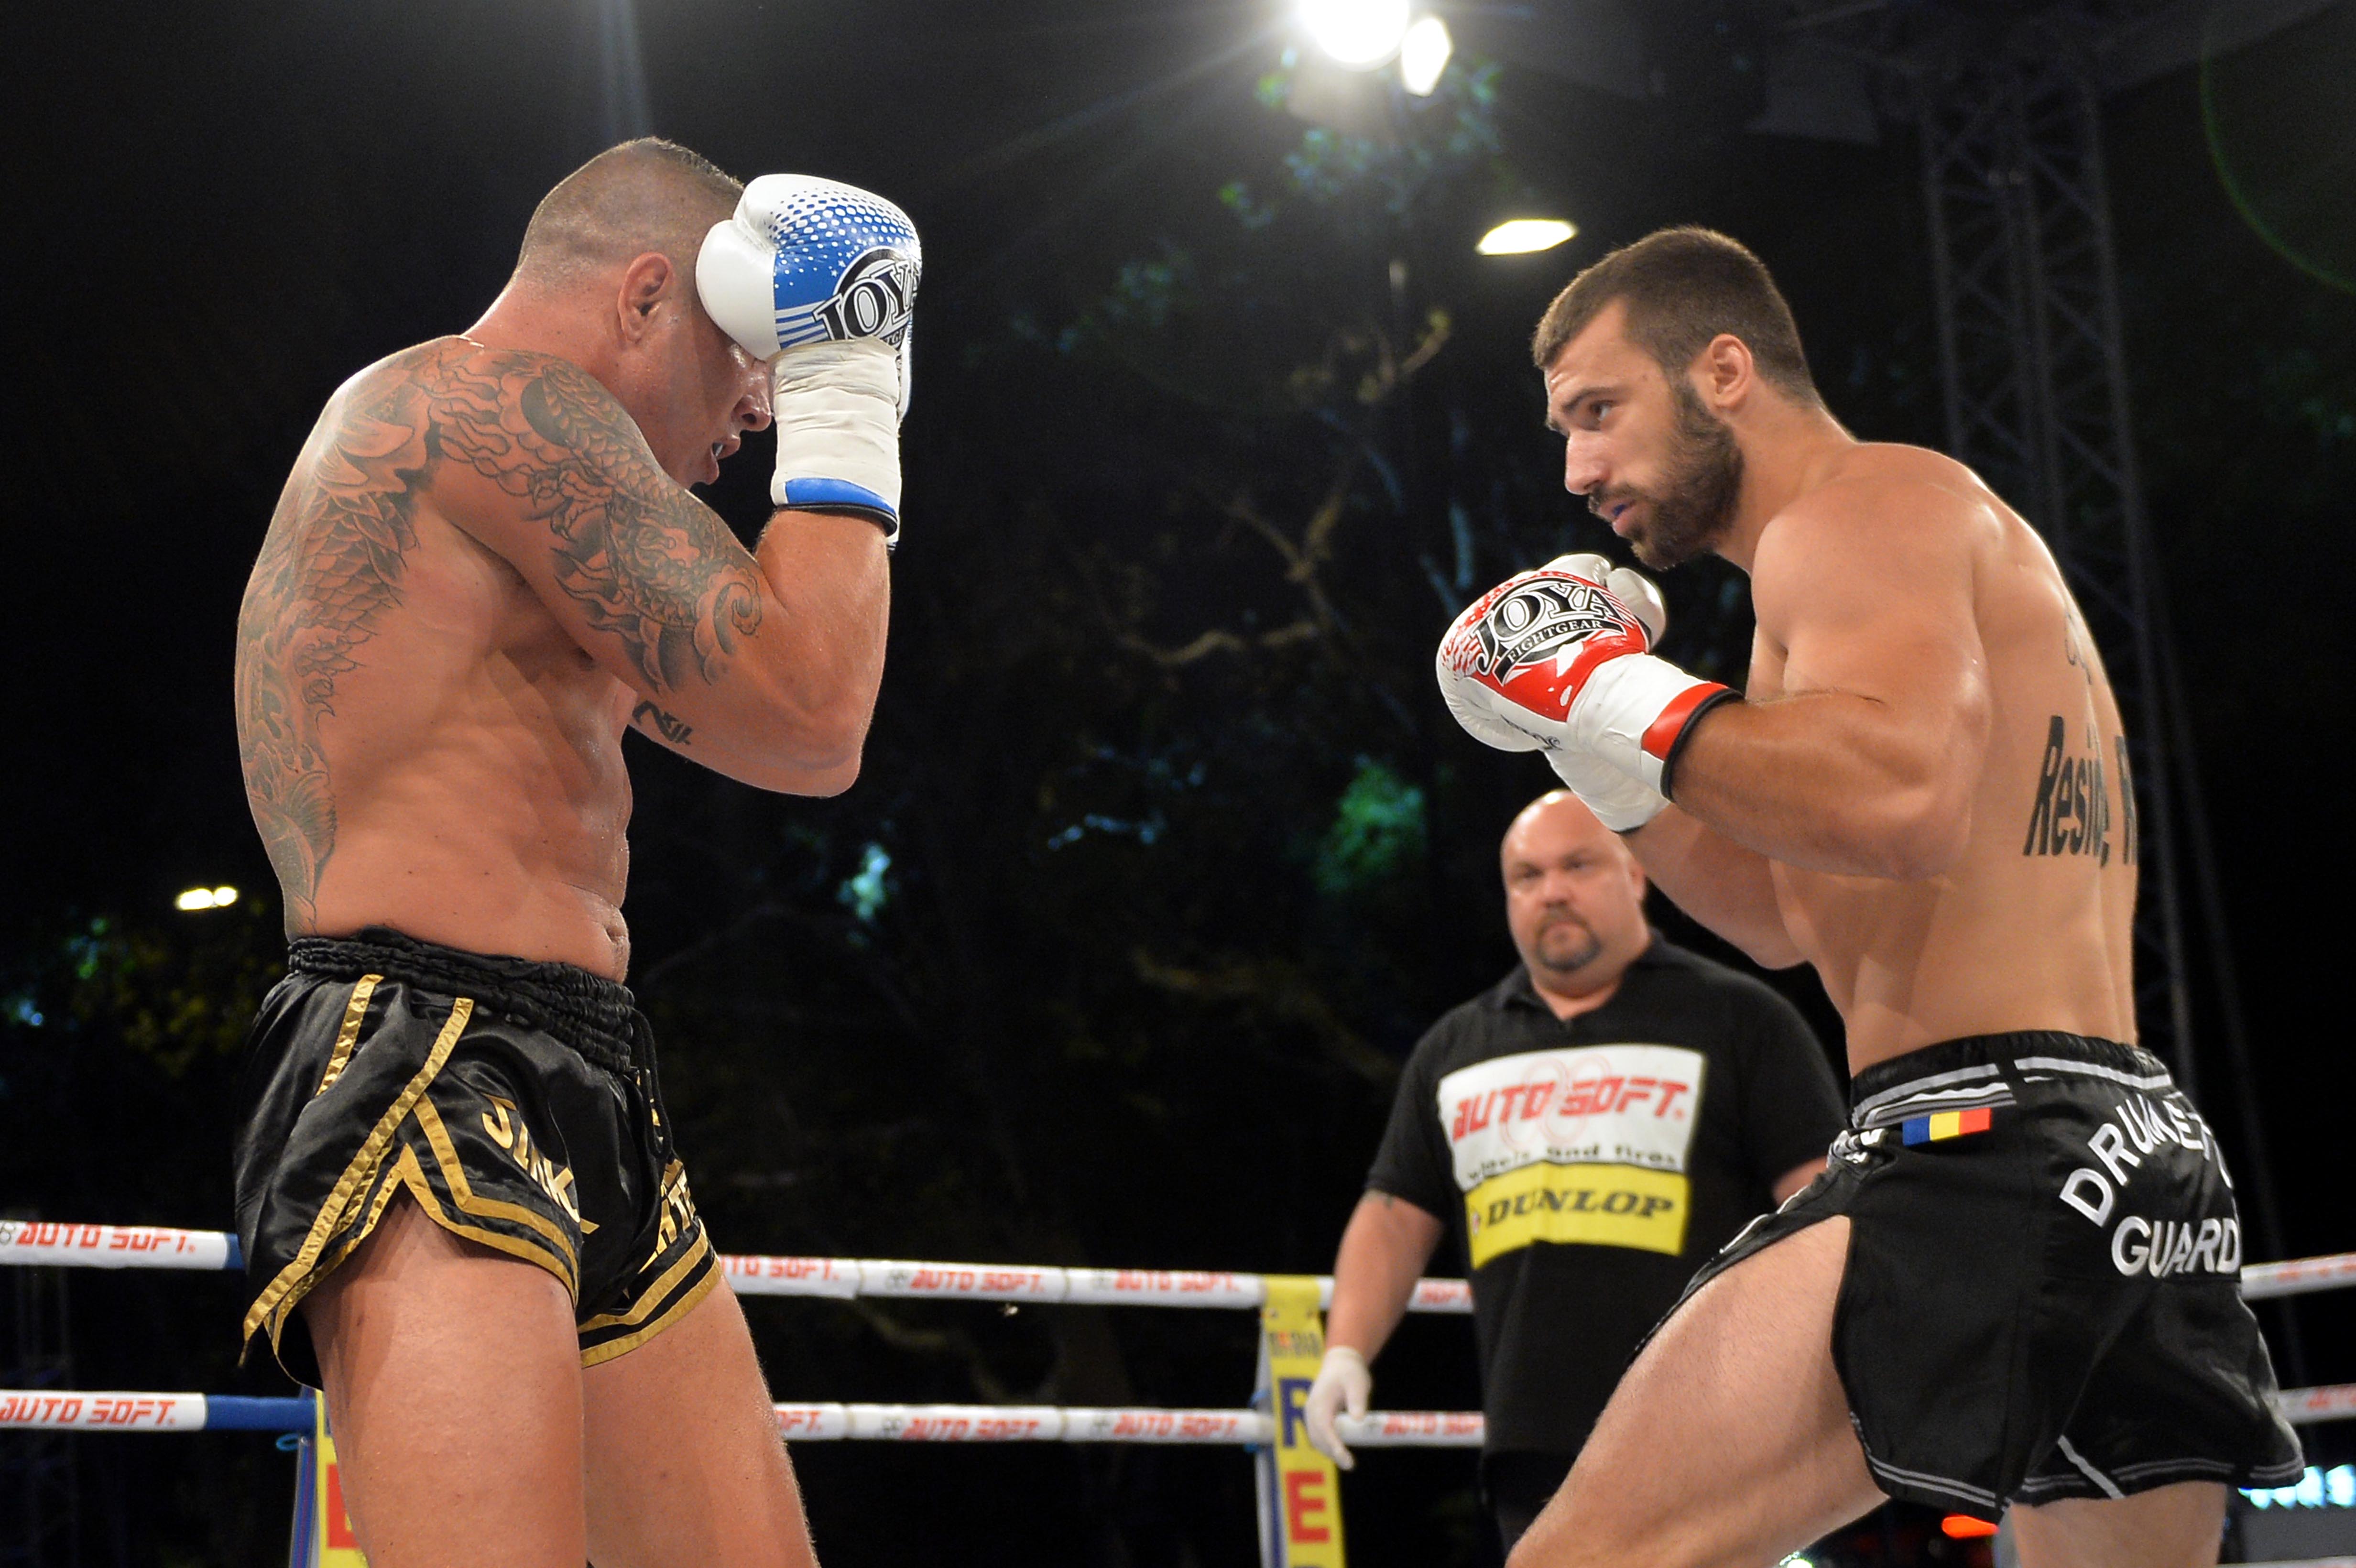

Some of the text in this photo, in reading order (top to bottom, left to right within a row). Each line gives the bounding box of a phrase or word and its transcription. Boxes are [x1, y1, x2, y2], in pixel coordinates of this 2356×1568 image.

[1472, 583, 1627, 675] JOYA
[1507, 620, 1603, 664] FIGHTGEAR
[1452, 1080, 1556, 1142] AUTO
[1487, 1187, 1674, 1227] DUNLOP
[16, 1222, 102, 1248] AUTO
[2112, 1216, 2240, 1278] GUARD
[910, 1269, 974, 1290] AUTO
[0, 1397, 83, 1423] AUTO
